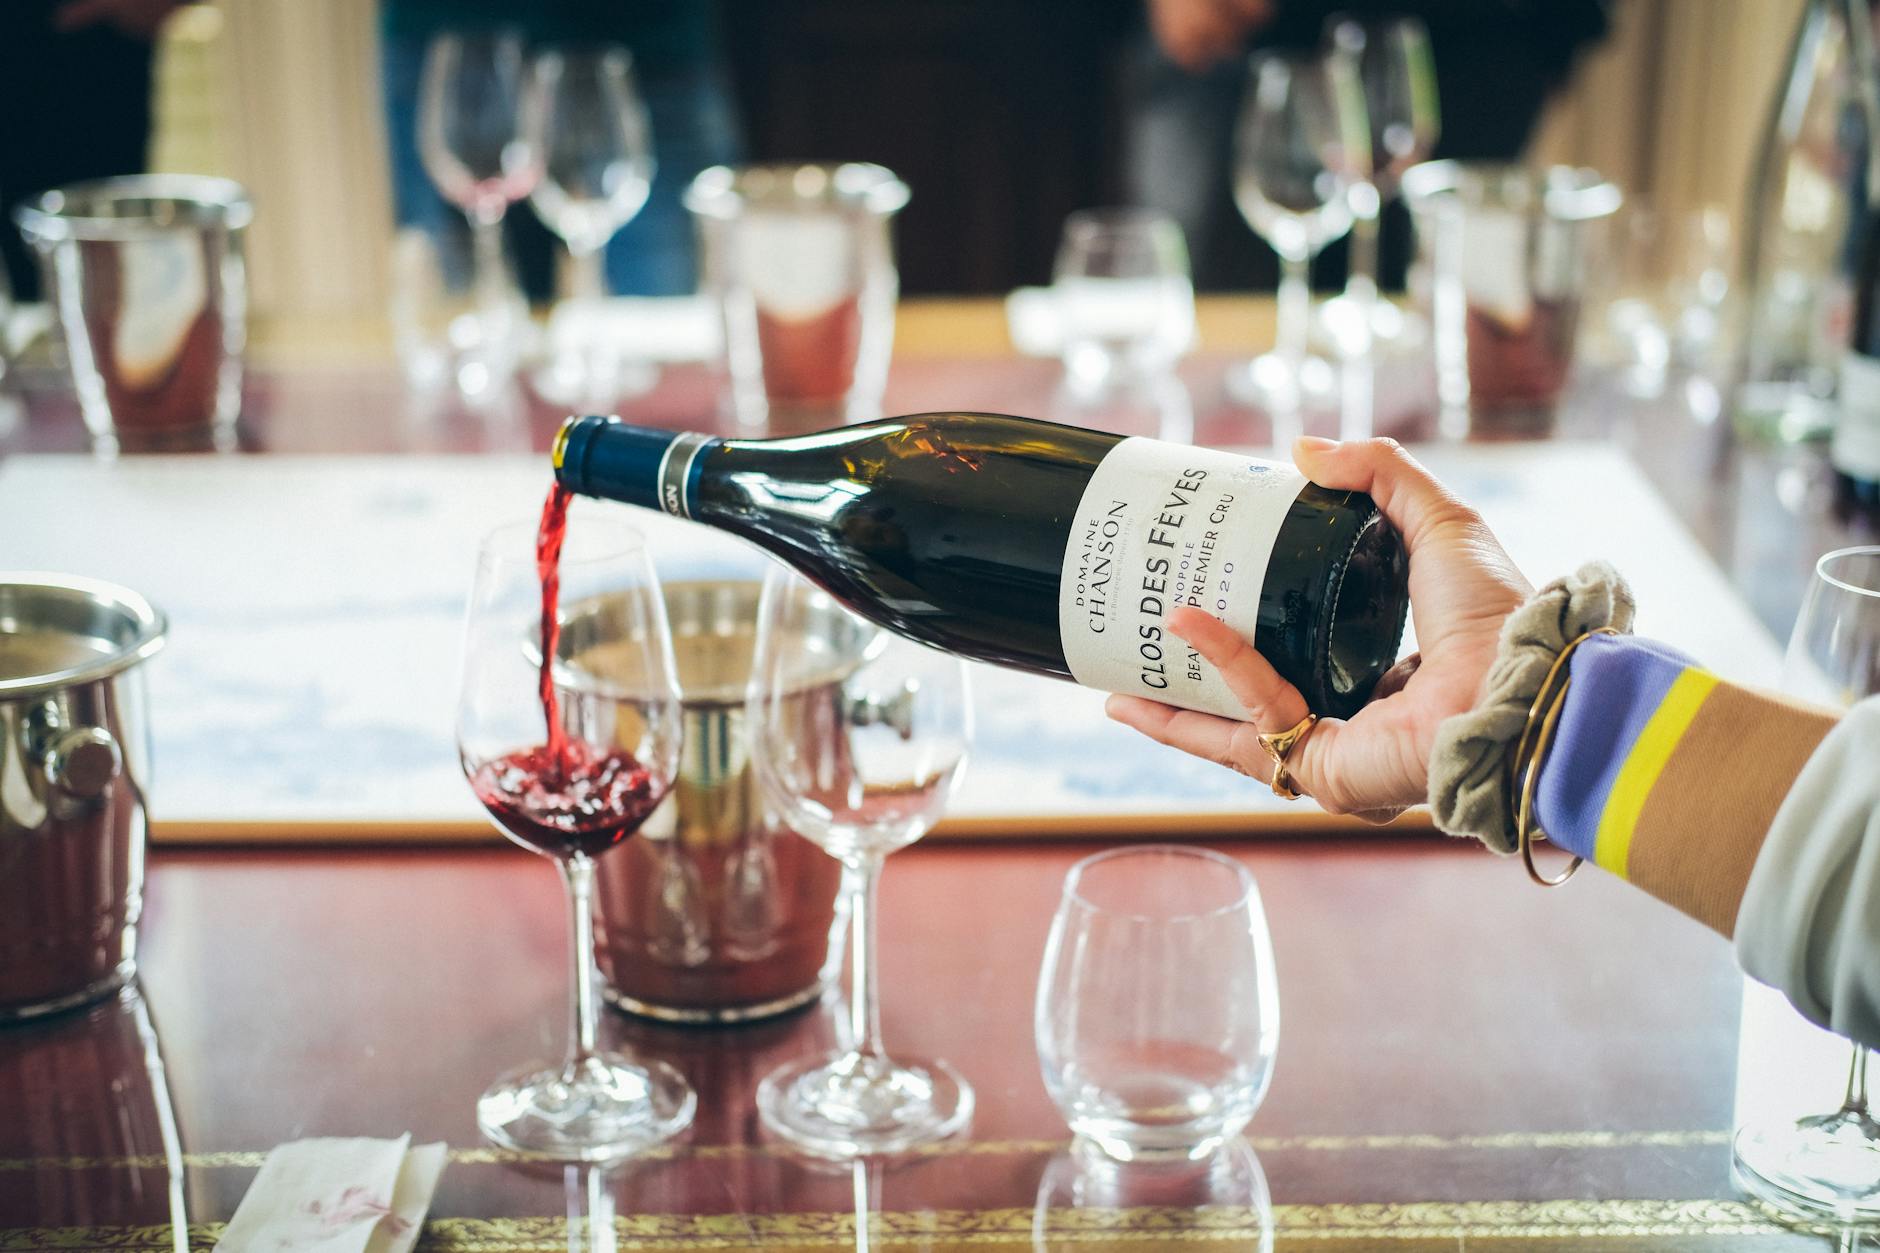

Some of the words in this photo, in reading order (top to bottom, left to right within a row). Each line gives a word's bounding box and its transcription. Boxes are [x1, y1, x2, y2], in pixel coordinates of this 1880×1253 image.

[1147, 467, 1208, 548] FÈVES
[1209, 493, 1235, 525] CRU
[1076, 519, 1099, 607] DOMAINE
[1089, 500, 1128, 634] CHANSON
[1140, 556, 1170, 618] DES
[1174, 541, 1195, 608] NOPOLE
[1187, 530, 1219, 609] PREMIER
[1139, 624, 1169, 690] CLOS
[1187, 645, 1202, 682] BEA
